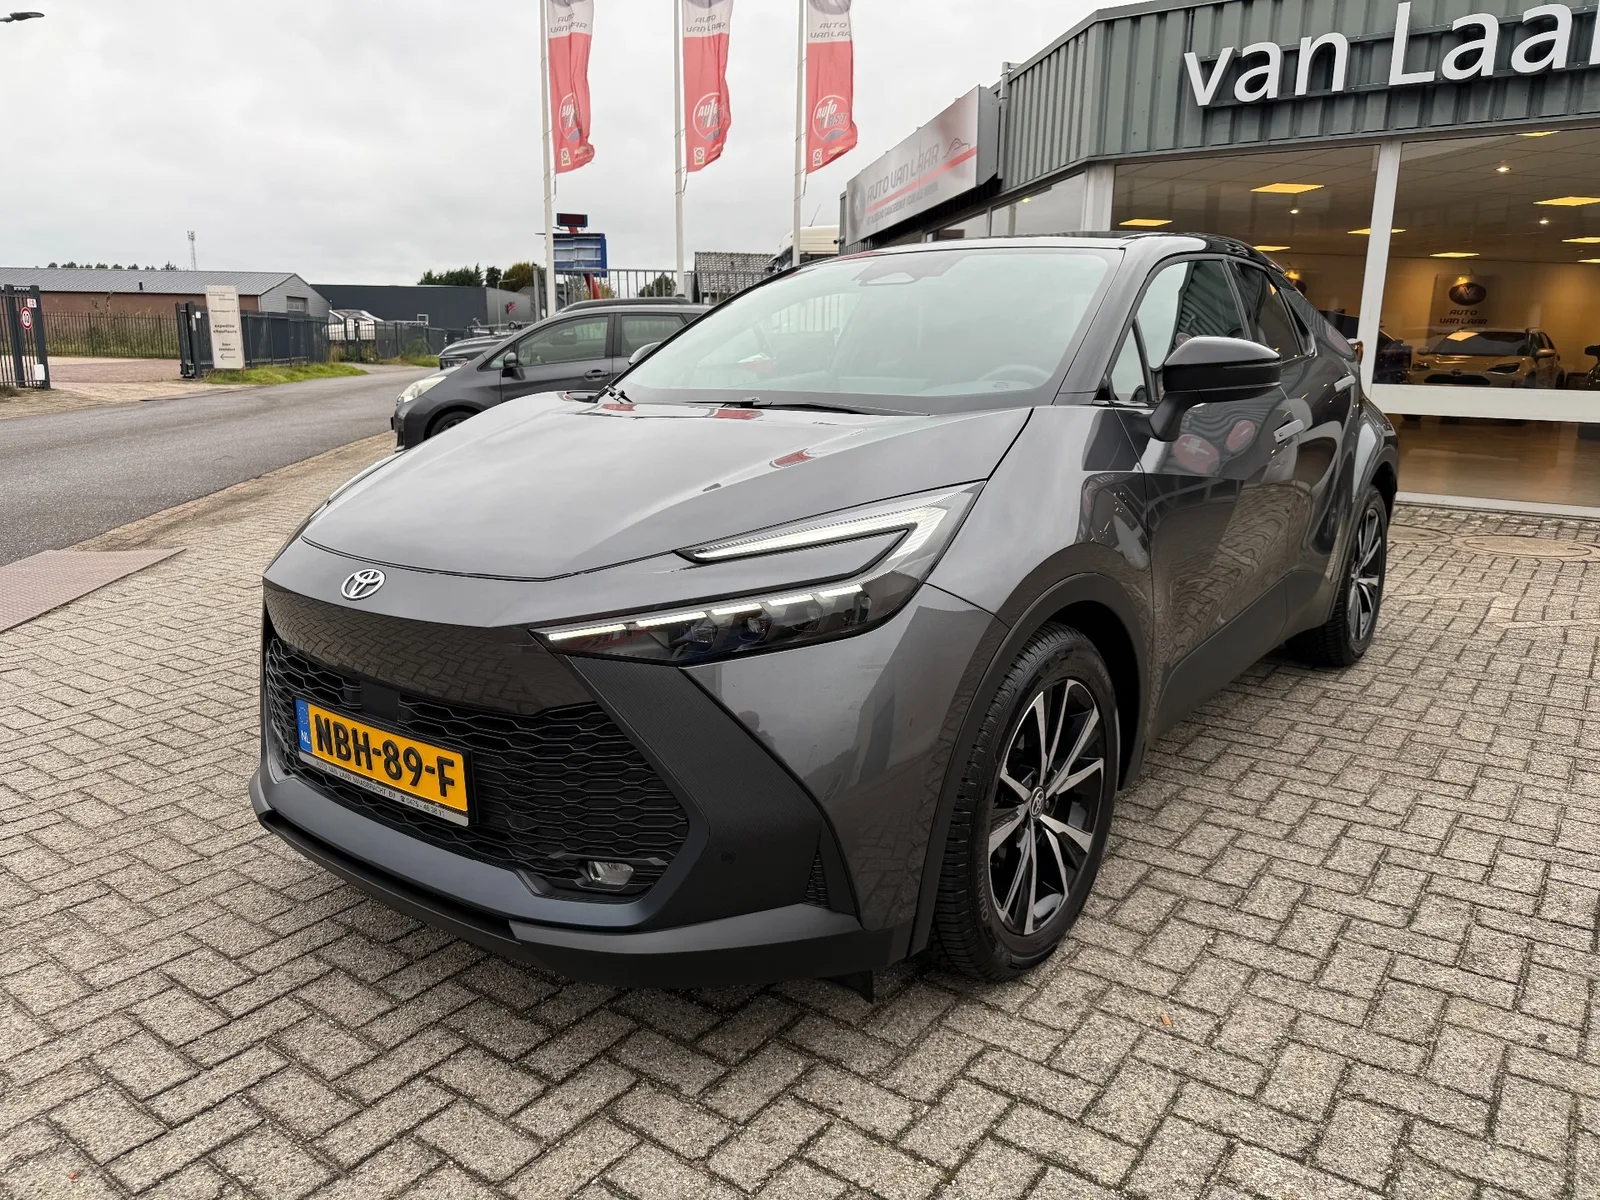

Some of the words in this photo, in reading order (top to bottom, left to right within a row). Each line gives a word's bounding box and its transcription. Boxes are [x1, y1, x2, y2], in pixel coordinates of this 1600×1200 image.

[1184, 31, 1348, 106] van
[867, 175, 889, 205] AUTO
[890, 162, 909, 189] VAN
[910, 142, 940, 177] LAAR
[300, 729, 311, 744] NL
[314, 713, 455, 797] NBH-89-F
